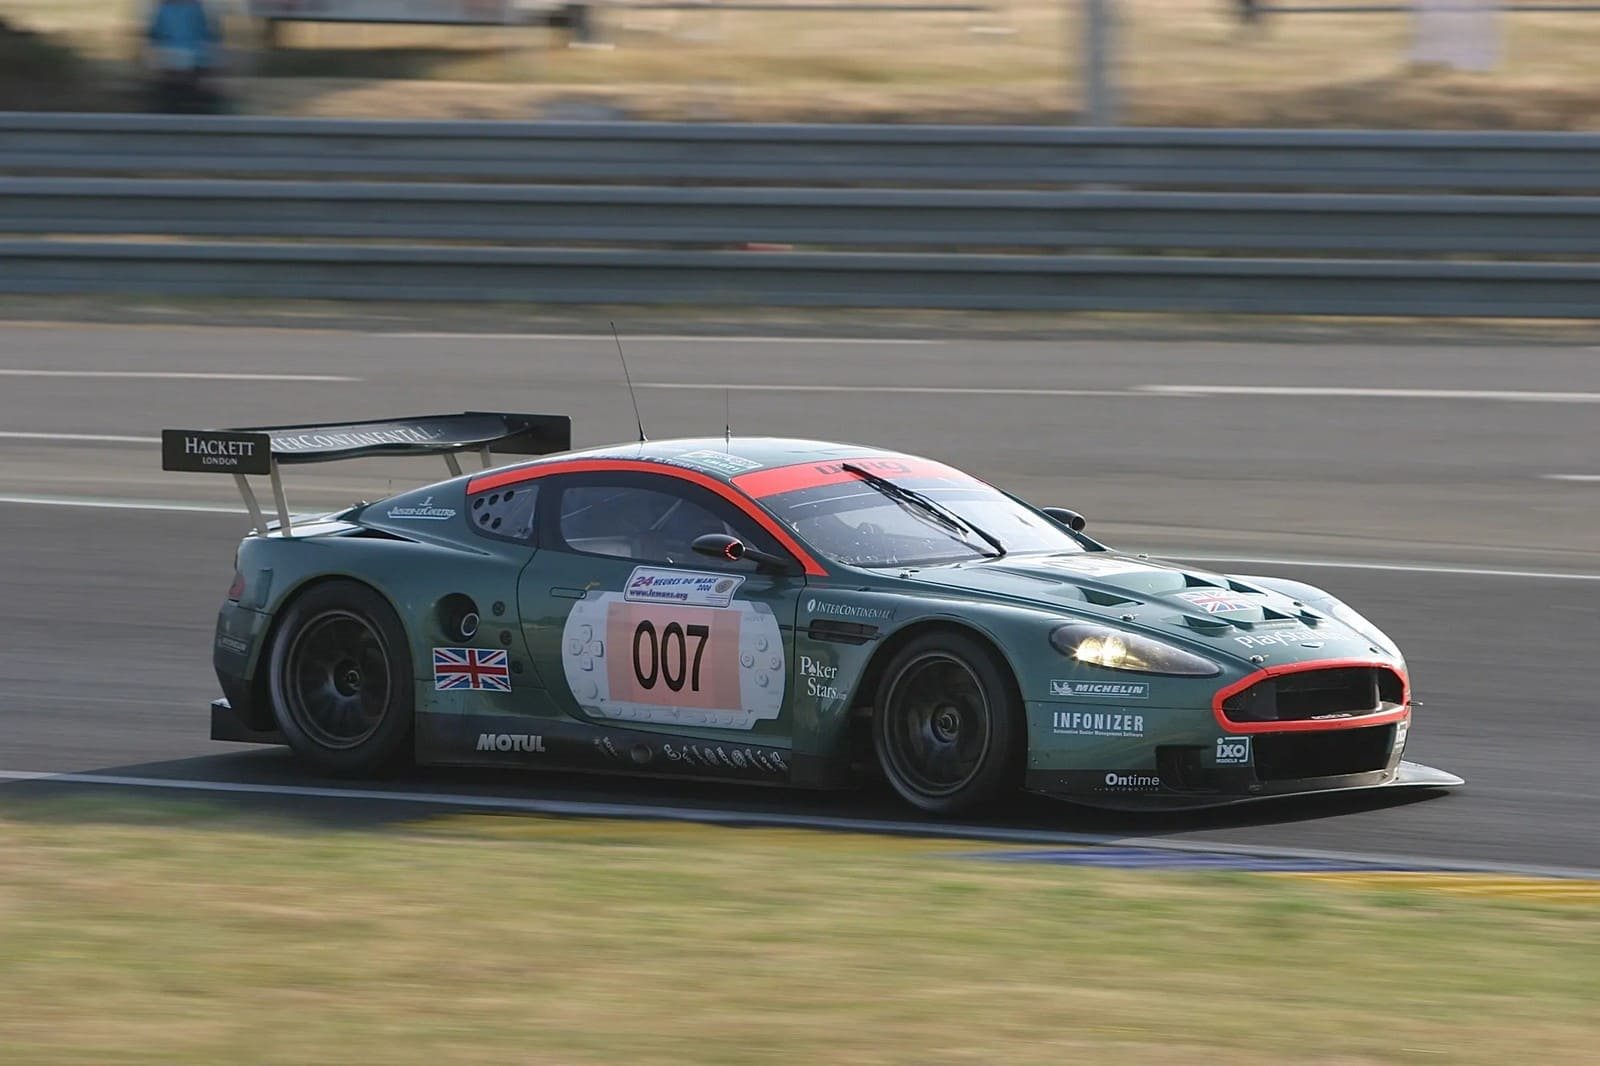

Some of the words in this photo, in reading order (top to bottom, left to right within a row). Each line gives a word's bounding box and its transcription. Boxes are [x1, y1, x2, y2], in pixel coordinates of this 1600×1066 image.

[185, 437, 255, 456] HACKETT
[270, 426, 437, 450] TERCONTINENTAL
[202, 456, 238, 465] LONDON
[631, 576, 656, 588] 24
[633, 620, 709, 692] 007
[1075, 684, 1144, 694] MICHELIN
[1053, 712, 1144, 731] INFONIZER
[476, 734, 546, 752] MOTUL
[1105, 773, 1160, 786] Ontime
